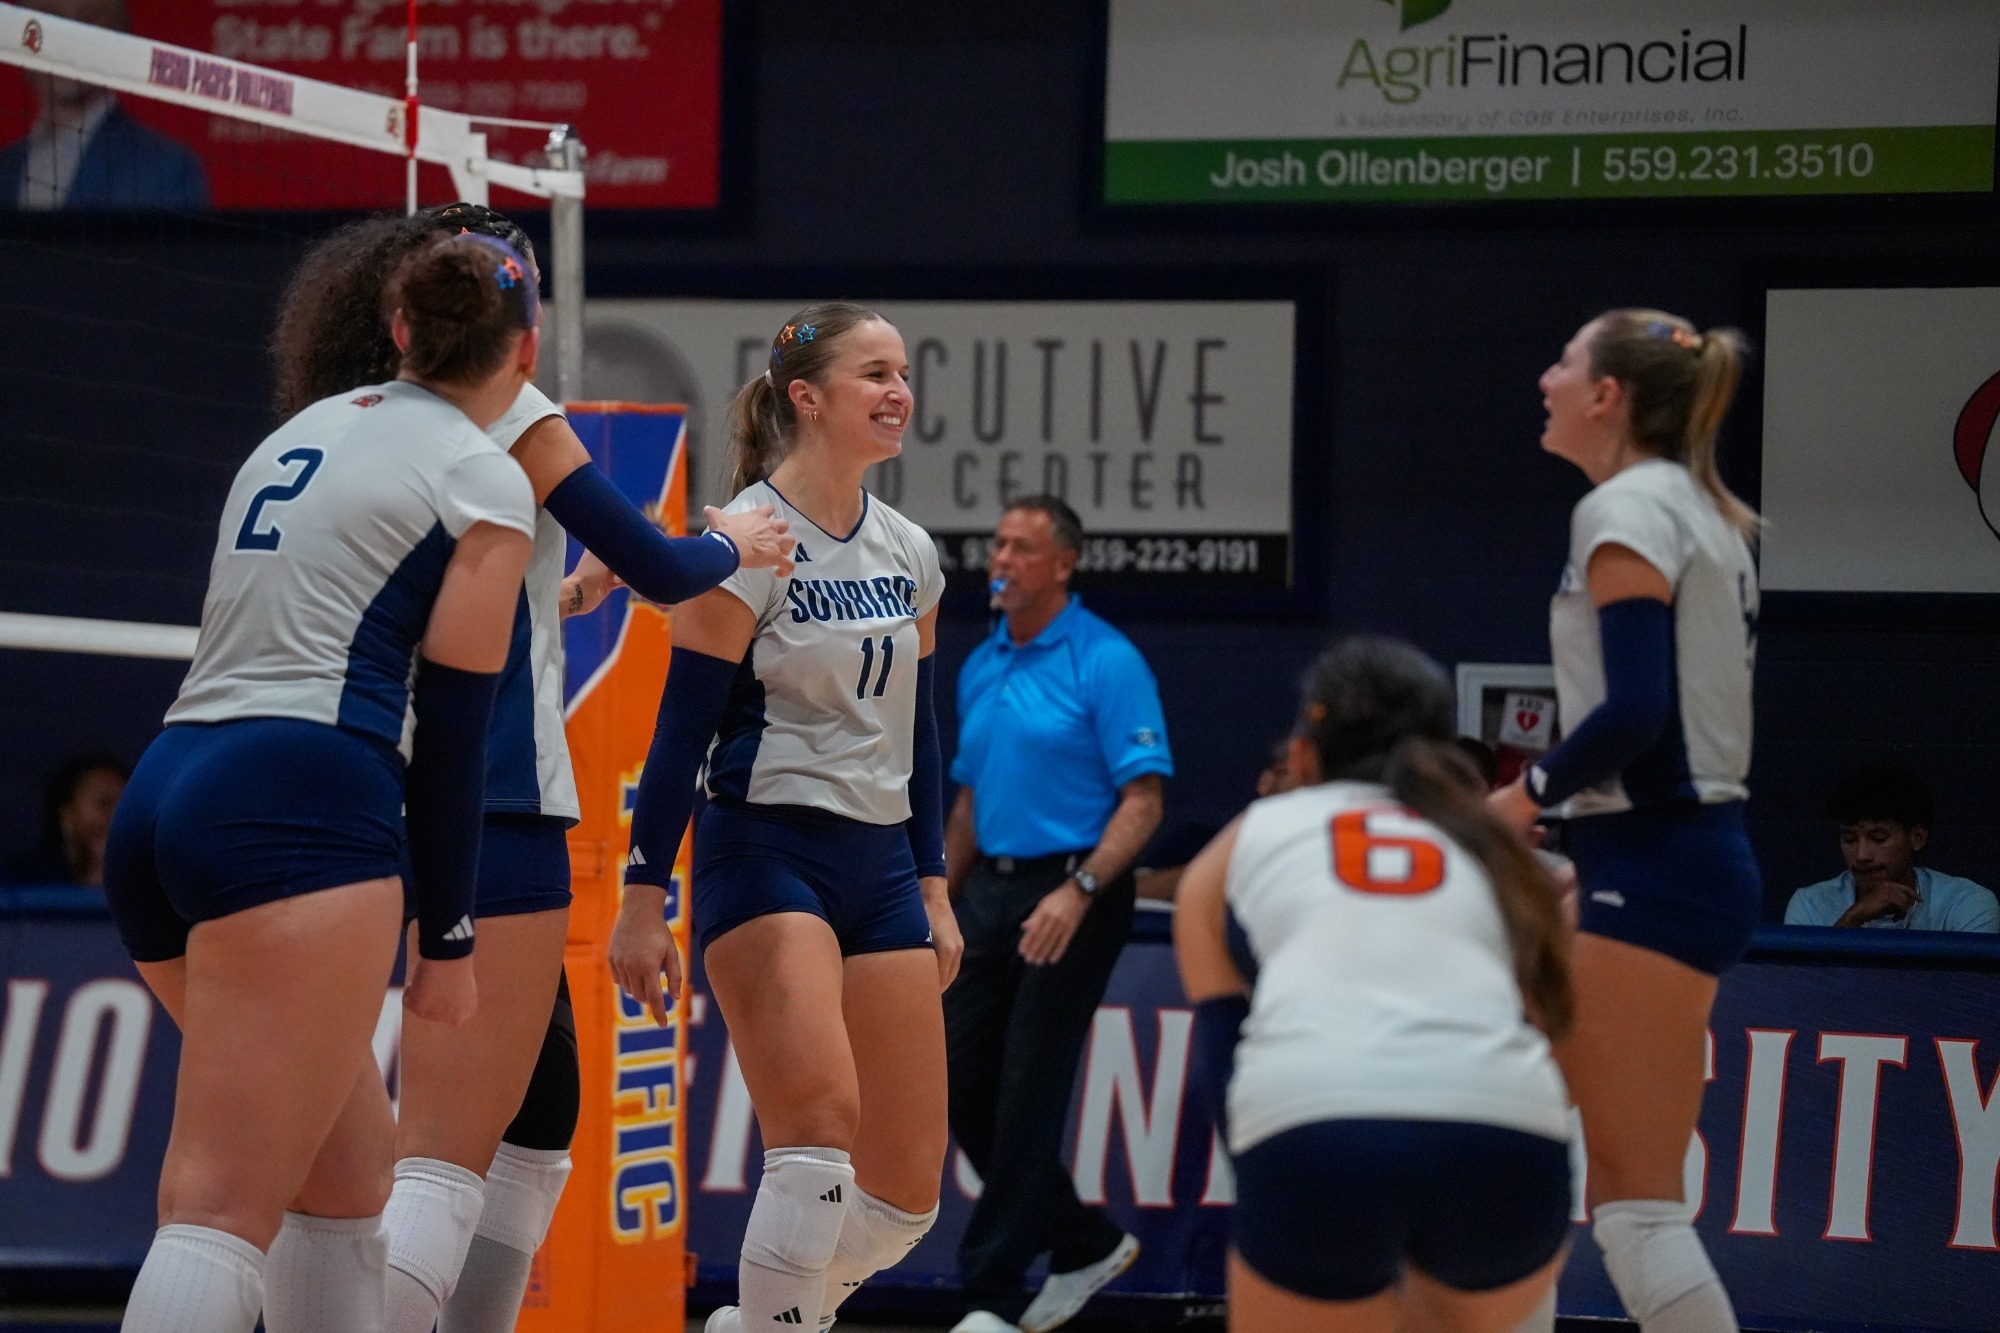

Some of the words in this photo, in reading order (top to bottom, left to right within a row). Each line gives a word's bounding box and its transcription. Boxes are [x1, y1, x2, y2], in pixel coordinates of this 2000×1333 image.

[212, 14, 333, 60] State
[469, 14, 507, 59] is
[1337, 24, 1747, 104] AgriFinancial
[1705, 105, 1744, 123] Inc.
[1210, 151, 1304, 187] Josh
[1317, 148, 1551, 191] Ollenberger
[1603, 142, 1875, 182] 559.231.3510
[736, 337, 1227, 444] CUTIVE
[233, 445, 327, 554] 2
[952, 451, 1206, 510] CENTER
[856, 635, 894, 701] 11
[1329, 803, 1446, 898] 6
